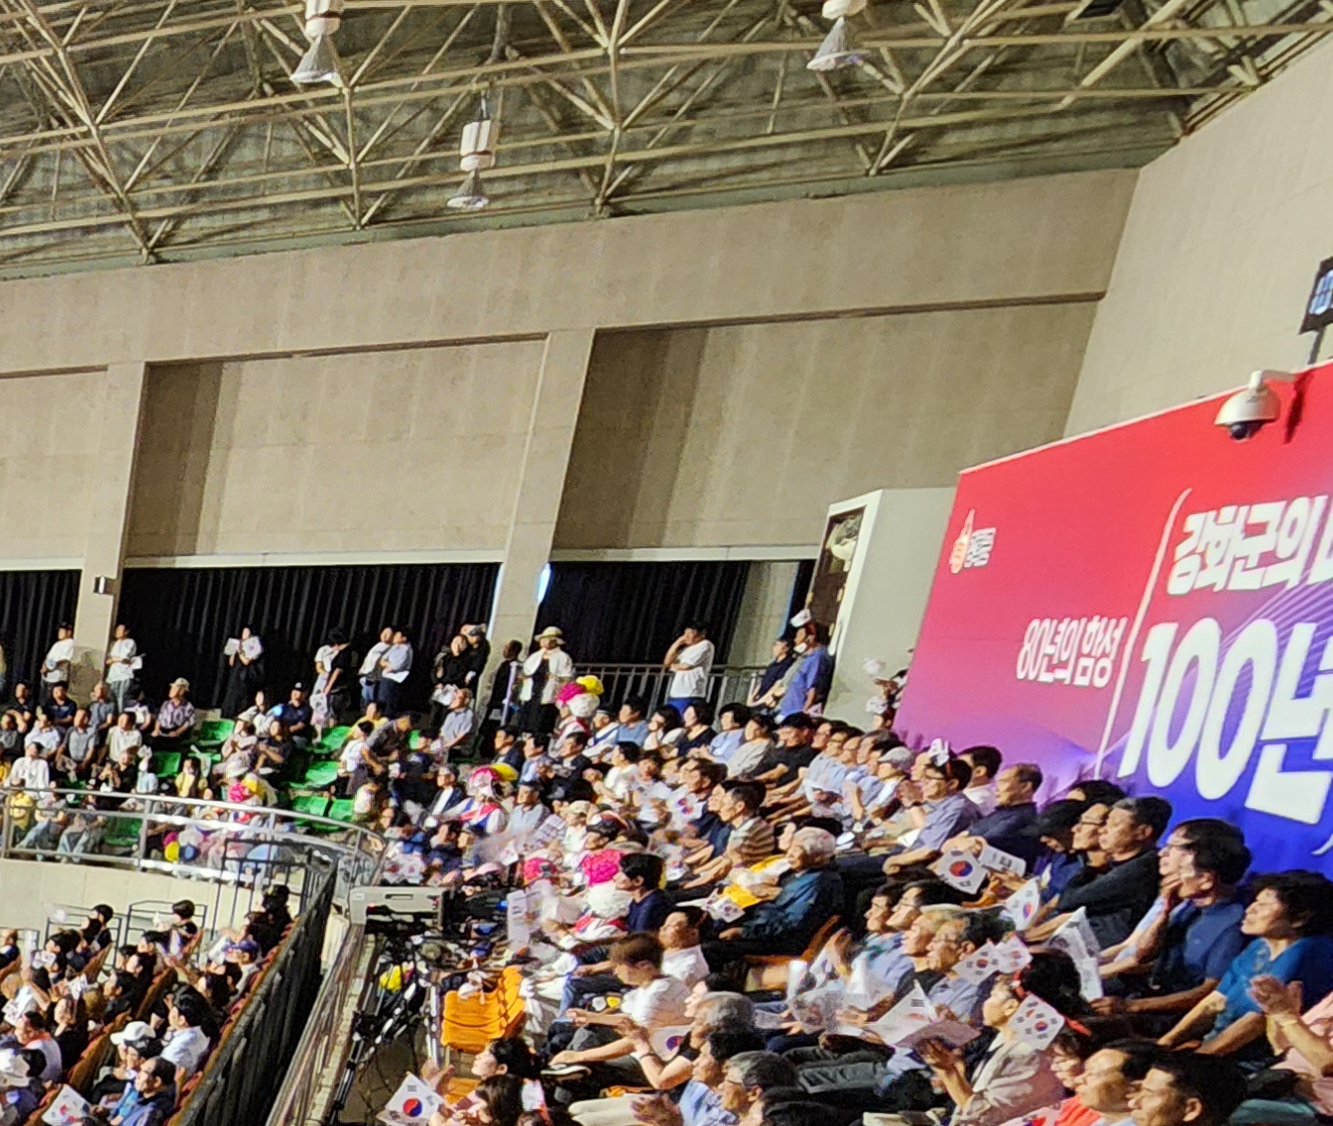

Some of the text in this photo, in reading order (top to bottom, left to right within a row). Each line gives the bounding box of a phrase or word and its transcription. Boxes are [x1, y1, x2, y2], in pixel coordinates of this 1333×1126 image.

[1167, 495, 1328, 595] 강화군의
[1016, 615, 1129, 688] 80년의 함성
[1117, 617, 1333, 825] 100년
